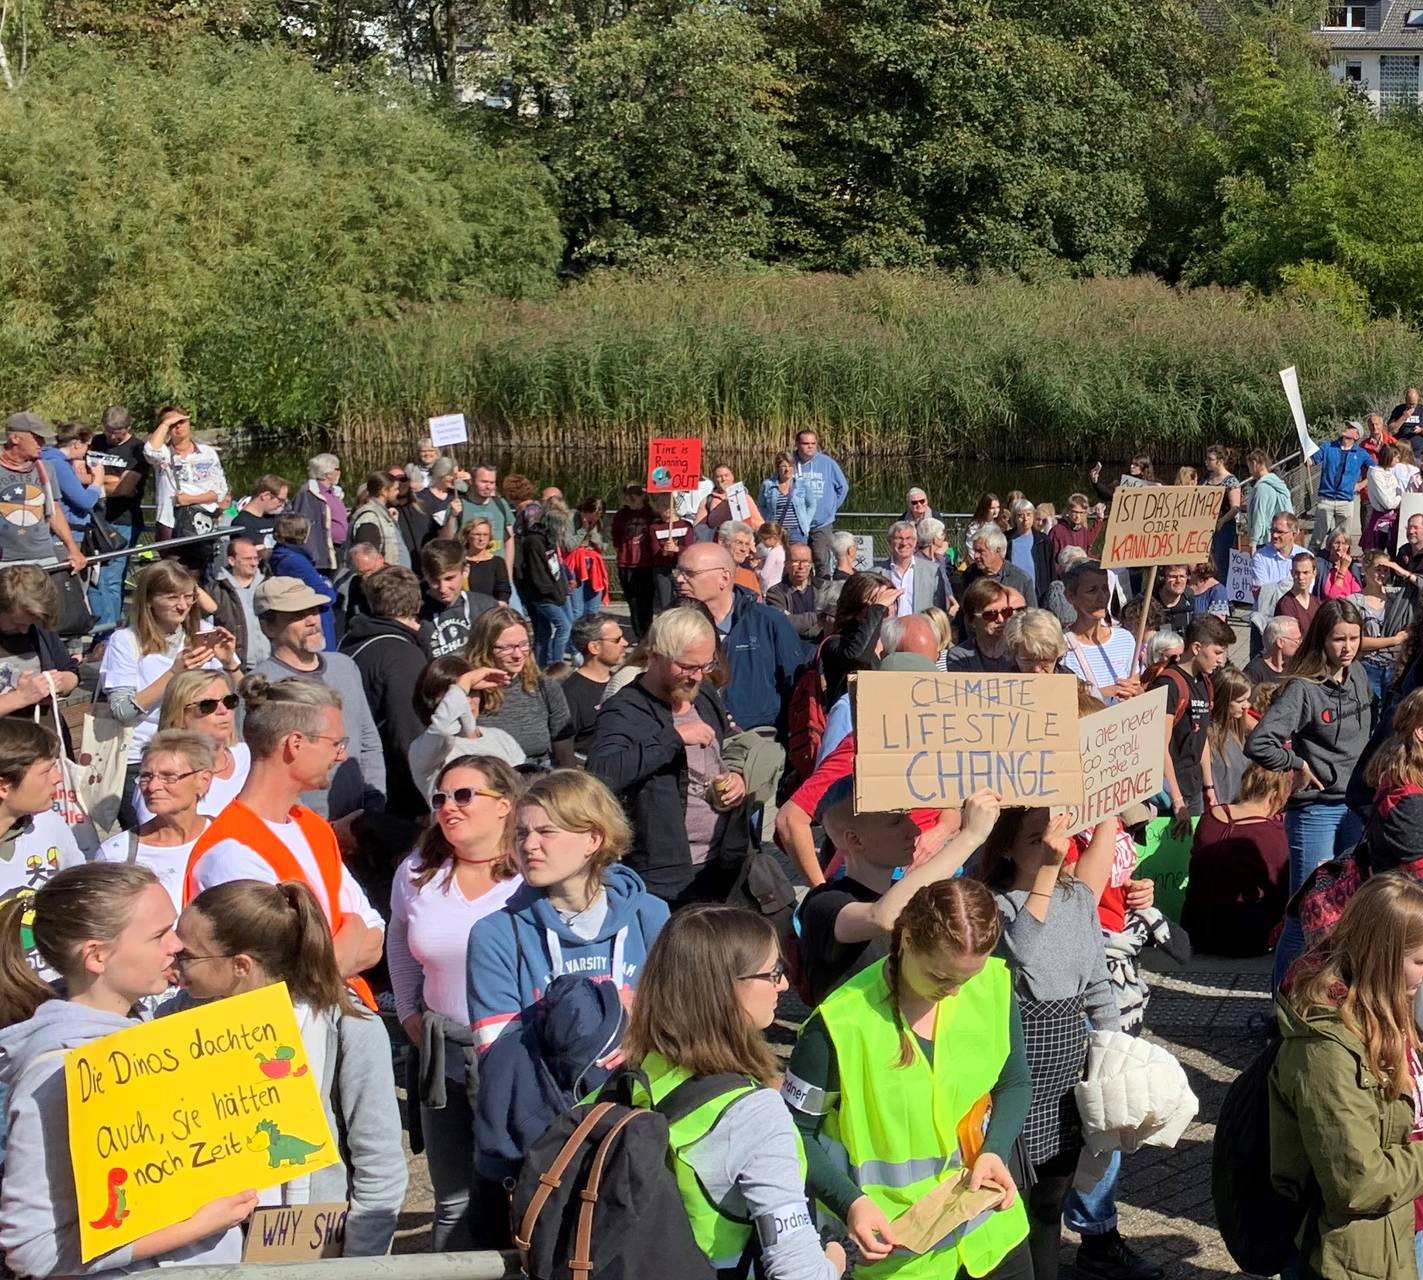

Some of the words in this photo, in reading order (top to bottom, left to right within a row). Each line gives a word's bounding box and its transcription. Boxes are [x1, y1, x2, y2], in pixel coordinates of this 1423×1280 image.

[655, 455, 688, 473] Running
[672, 473, 699, 489] OUT
[1143, 519, 1179, 534] ODER
[911, 677, 1036, 711] CLIMATE
[882, 711, 1060, 749] LIFESTYLE
[1095, 722, 1119, 749] are
[1121, 705, 1159, 734] never
[1108, 733, 1140, 758] small
[905, 750, 1060, 801] CHANGE
[1099, 758, 1129, 784] make
[565, 956, 607, 974] VARSITY
[77, 1057, 105, 1104] Die
[108, 1048, 180, 1085] Dinos
[189, 1023, 278, 1060] dachten
[783, 1078, 807, 1101] rdner
[96, 1111, 165, 1159] auch,
[211, 1084, 281, 1121] hätten
[133, 1151, 184, 1187] noch
[188, 1132, 243, 1169] Zeit
[262, 1207, 304, 1248] WHY
[309, 1210, 348, 1250] SHO
[774, 1210, 810, 1235] Ordne
